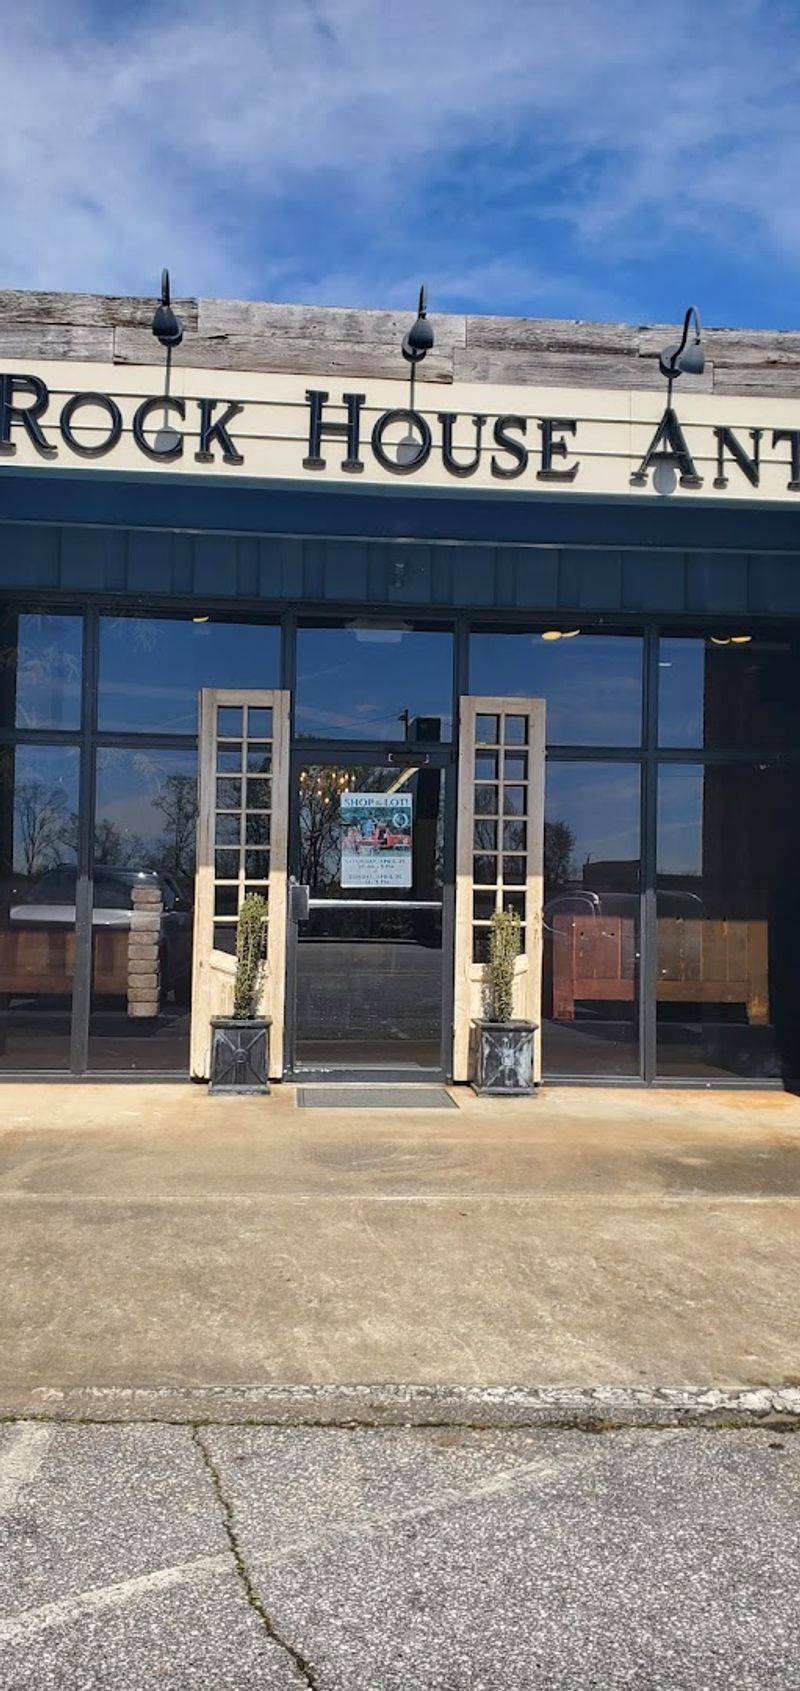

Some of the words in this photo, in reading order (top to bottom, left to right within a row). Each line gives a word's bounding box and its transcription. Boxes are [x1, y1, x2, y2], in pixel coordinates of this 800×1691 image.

[0, 373, 244, 466] ROCK
[303, 389, 580, 482] HOUSE
[630, 408, 800, 491] ANT
[344, 798, 374, 807] SHOP
